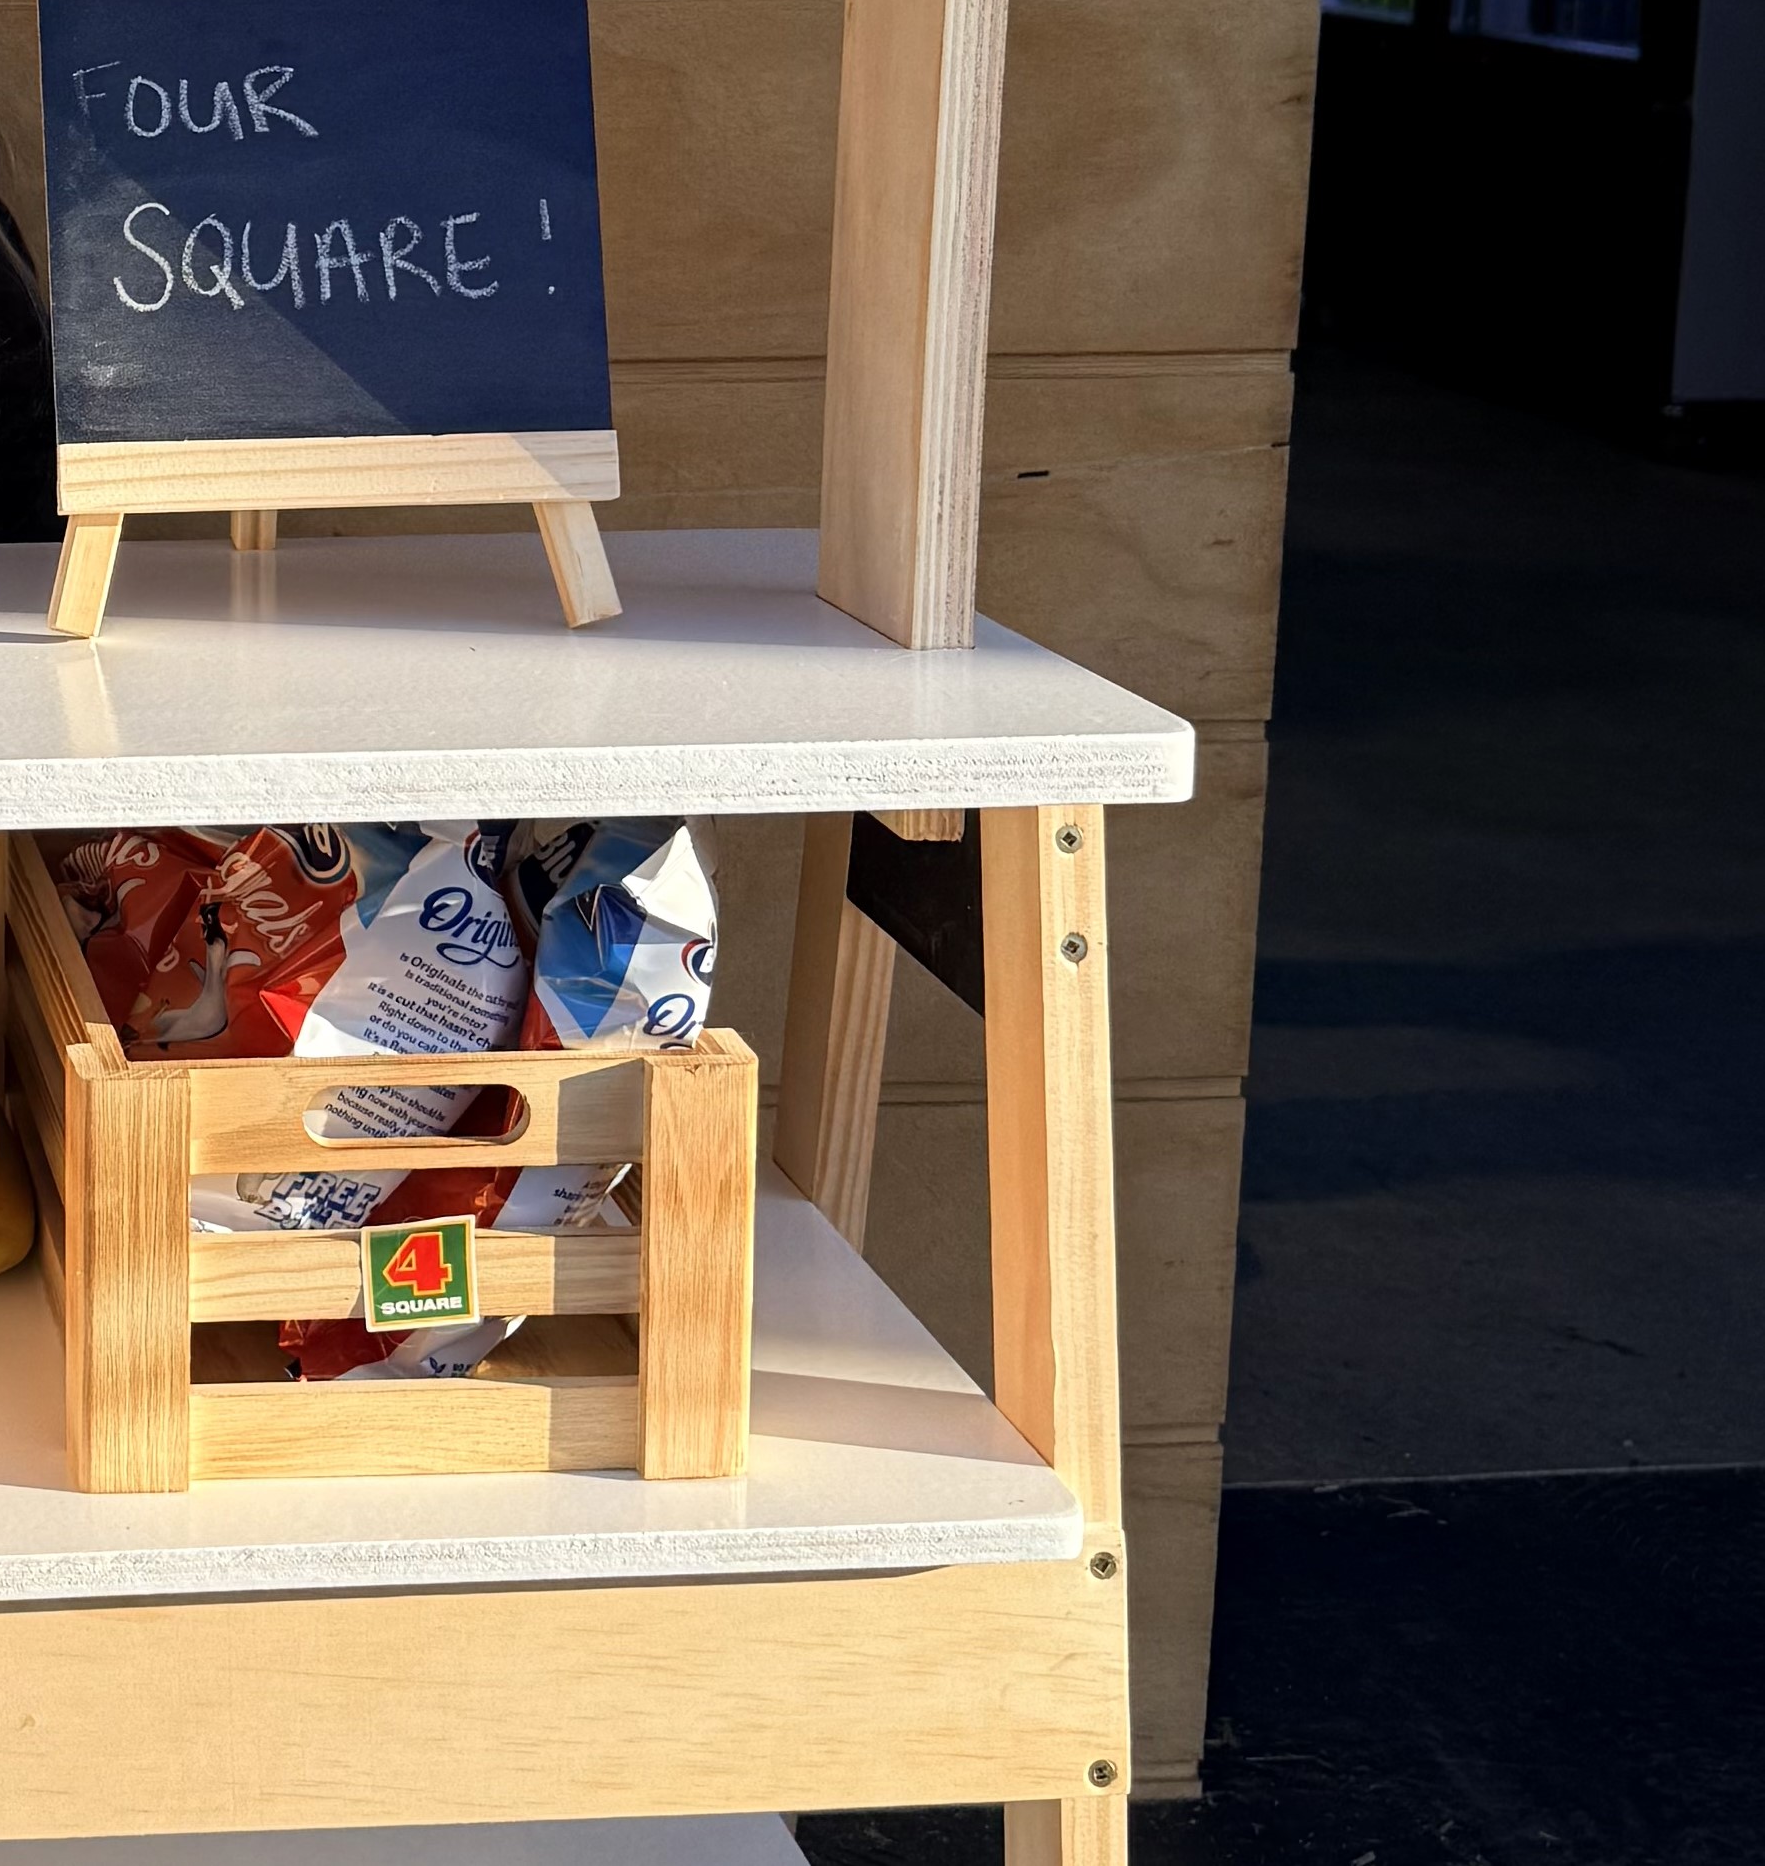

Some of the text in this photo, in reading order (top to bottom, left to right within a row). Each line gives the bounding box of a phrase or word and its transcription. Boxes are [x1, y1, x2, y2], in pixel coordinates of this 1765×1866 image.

[72, 60, 319, 141] FOUR
[411, 956, 467, 992] Originals
[415, 975, 470, 1009] traditional
[395, 996, 417, 1010] cut
[416, 1004, 439, 1022] that
[424, 997, 459, 1018] you're
[378, 1000, 407, 1020] Right
[406, 1014, 437, 1037] down
[436, 1031, 449, 1045] to
[396, 1029, 417, 1044] you
[337, 1090, 375, 1117] because
[367, 1093, 388, 1109] now
[324, 1103, 363, 1129] nothing
[382, 1231, 453, 1297] 4
[380, 1296, 463, 1316] SQUARE
